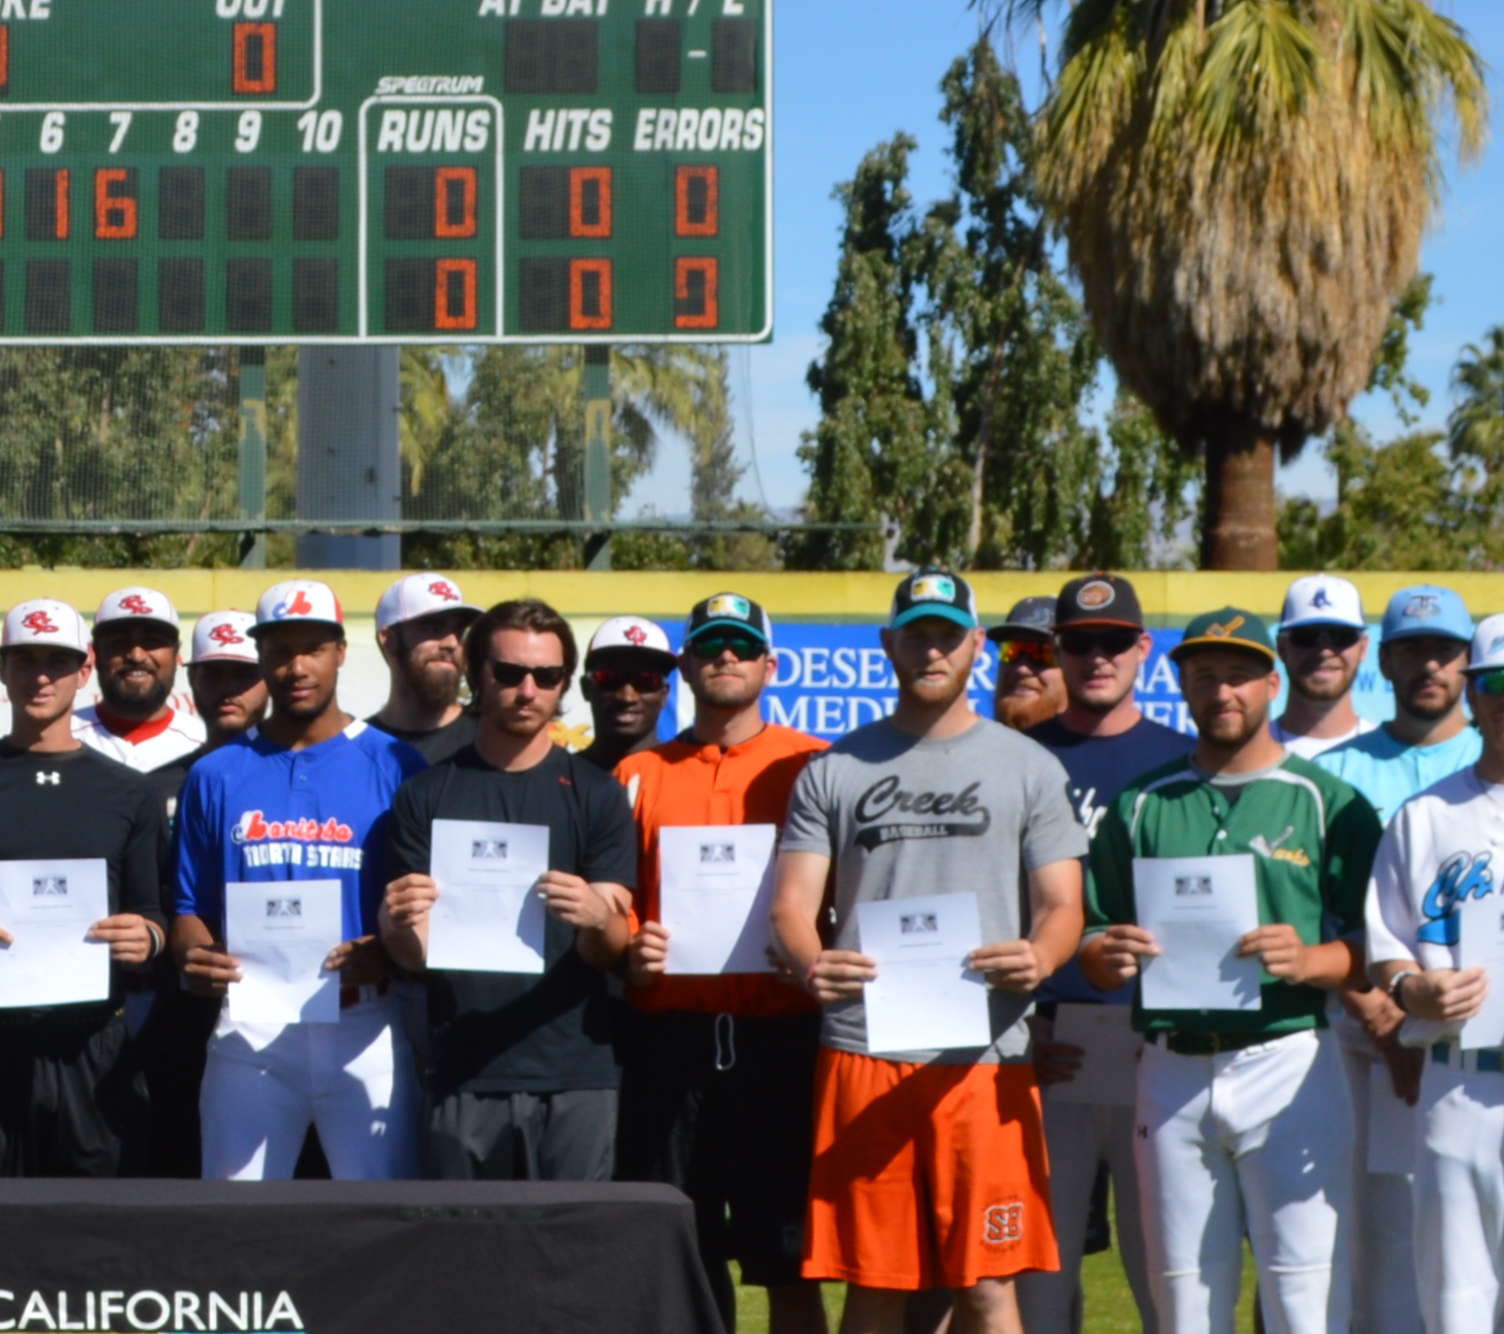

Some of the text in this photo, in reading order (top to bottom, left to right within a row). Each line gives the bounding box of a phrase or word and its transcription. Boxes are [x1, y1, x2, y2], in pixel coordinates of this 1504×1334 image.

[375, 75, 485, 96] SPECTRUM
[38, 113, 66, 155] 6
[107, 111, 132, 153] 7
[172, 111, 199, 153] 8
[234, 111, 262, 153] 9
[296, 111, 343, 153] 10
[376, 109, 491, 153] RUNS
[524, 108, 613, 151] HITS
[633, 107, 765, 152] ERRORS
[854, 774, 982, 825] Creek
